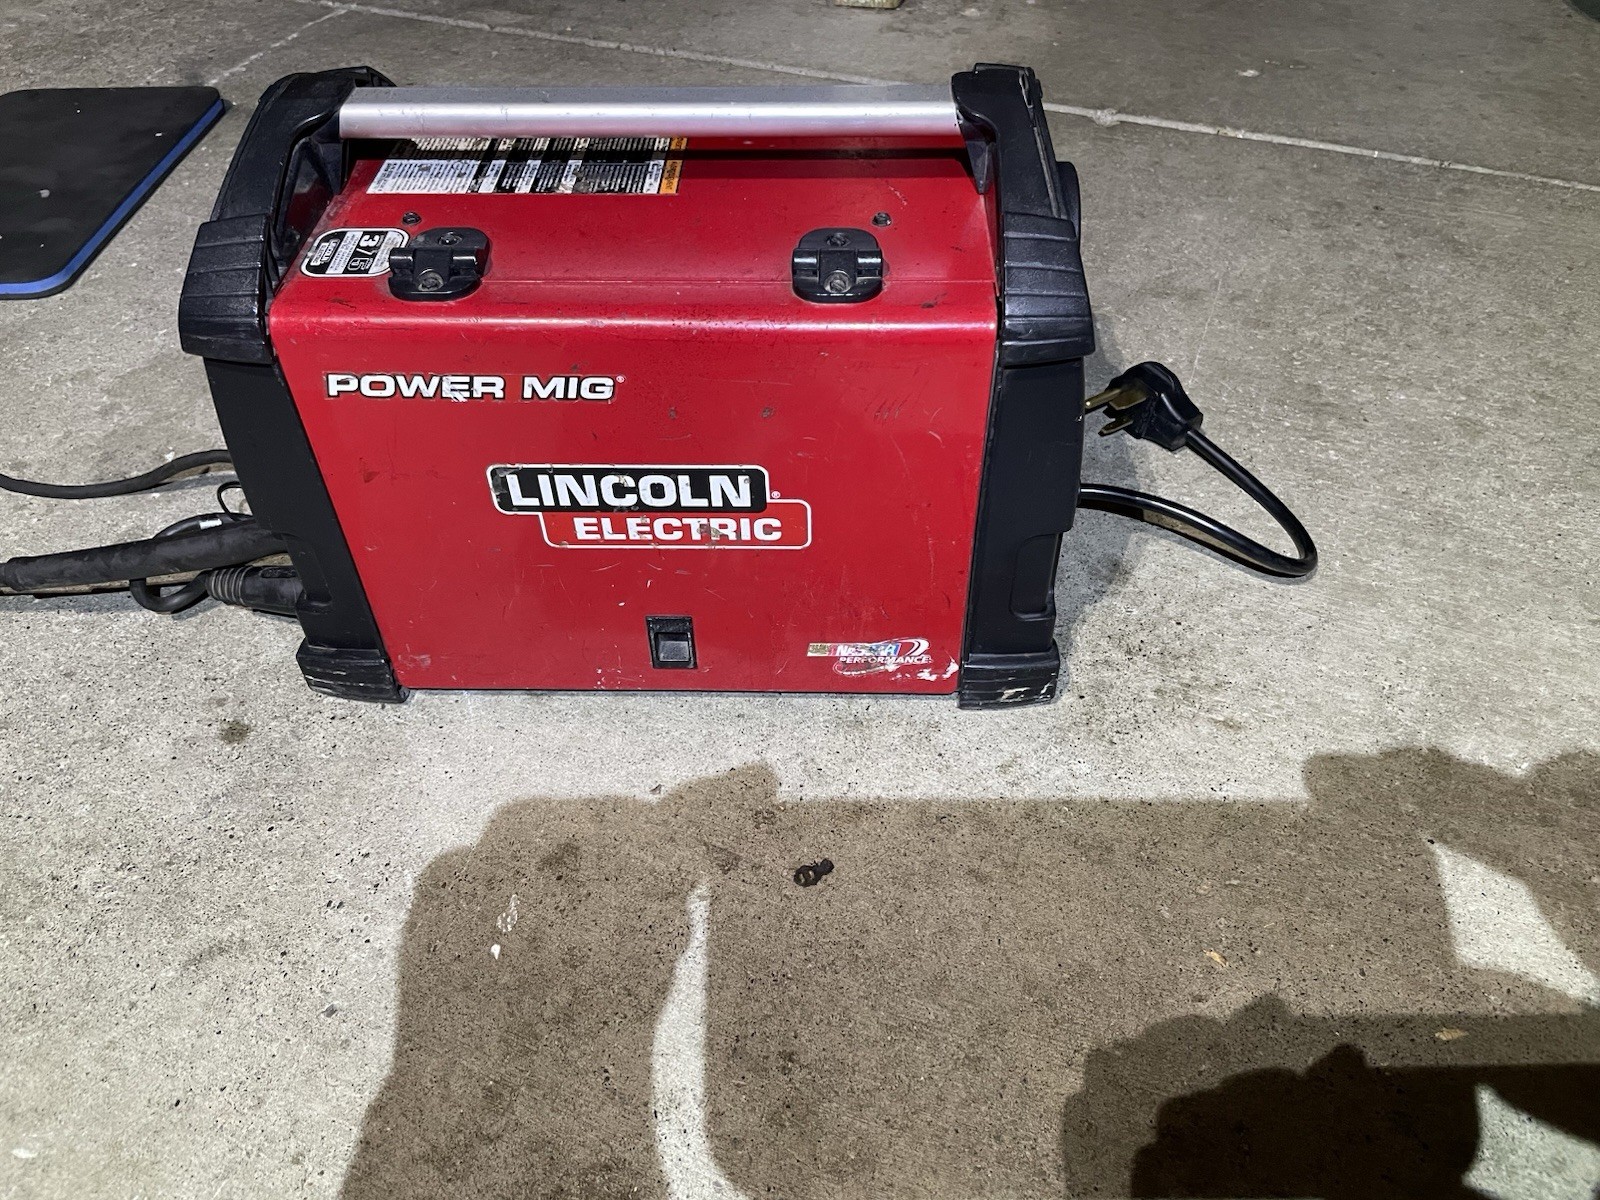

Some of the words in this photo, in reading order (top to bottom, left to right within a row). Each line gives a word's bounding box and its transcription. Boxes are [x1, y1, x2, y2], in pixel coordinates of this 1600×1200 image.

[327, 374, 504, 399] POWER
[522, 376, 614, 400] MIG
[506, 475, 752, 507] LINCOLN
[573, 517, 783, 541] ELECTRIC
[839, 656, 929, 664] PERFORMANCE
